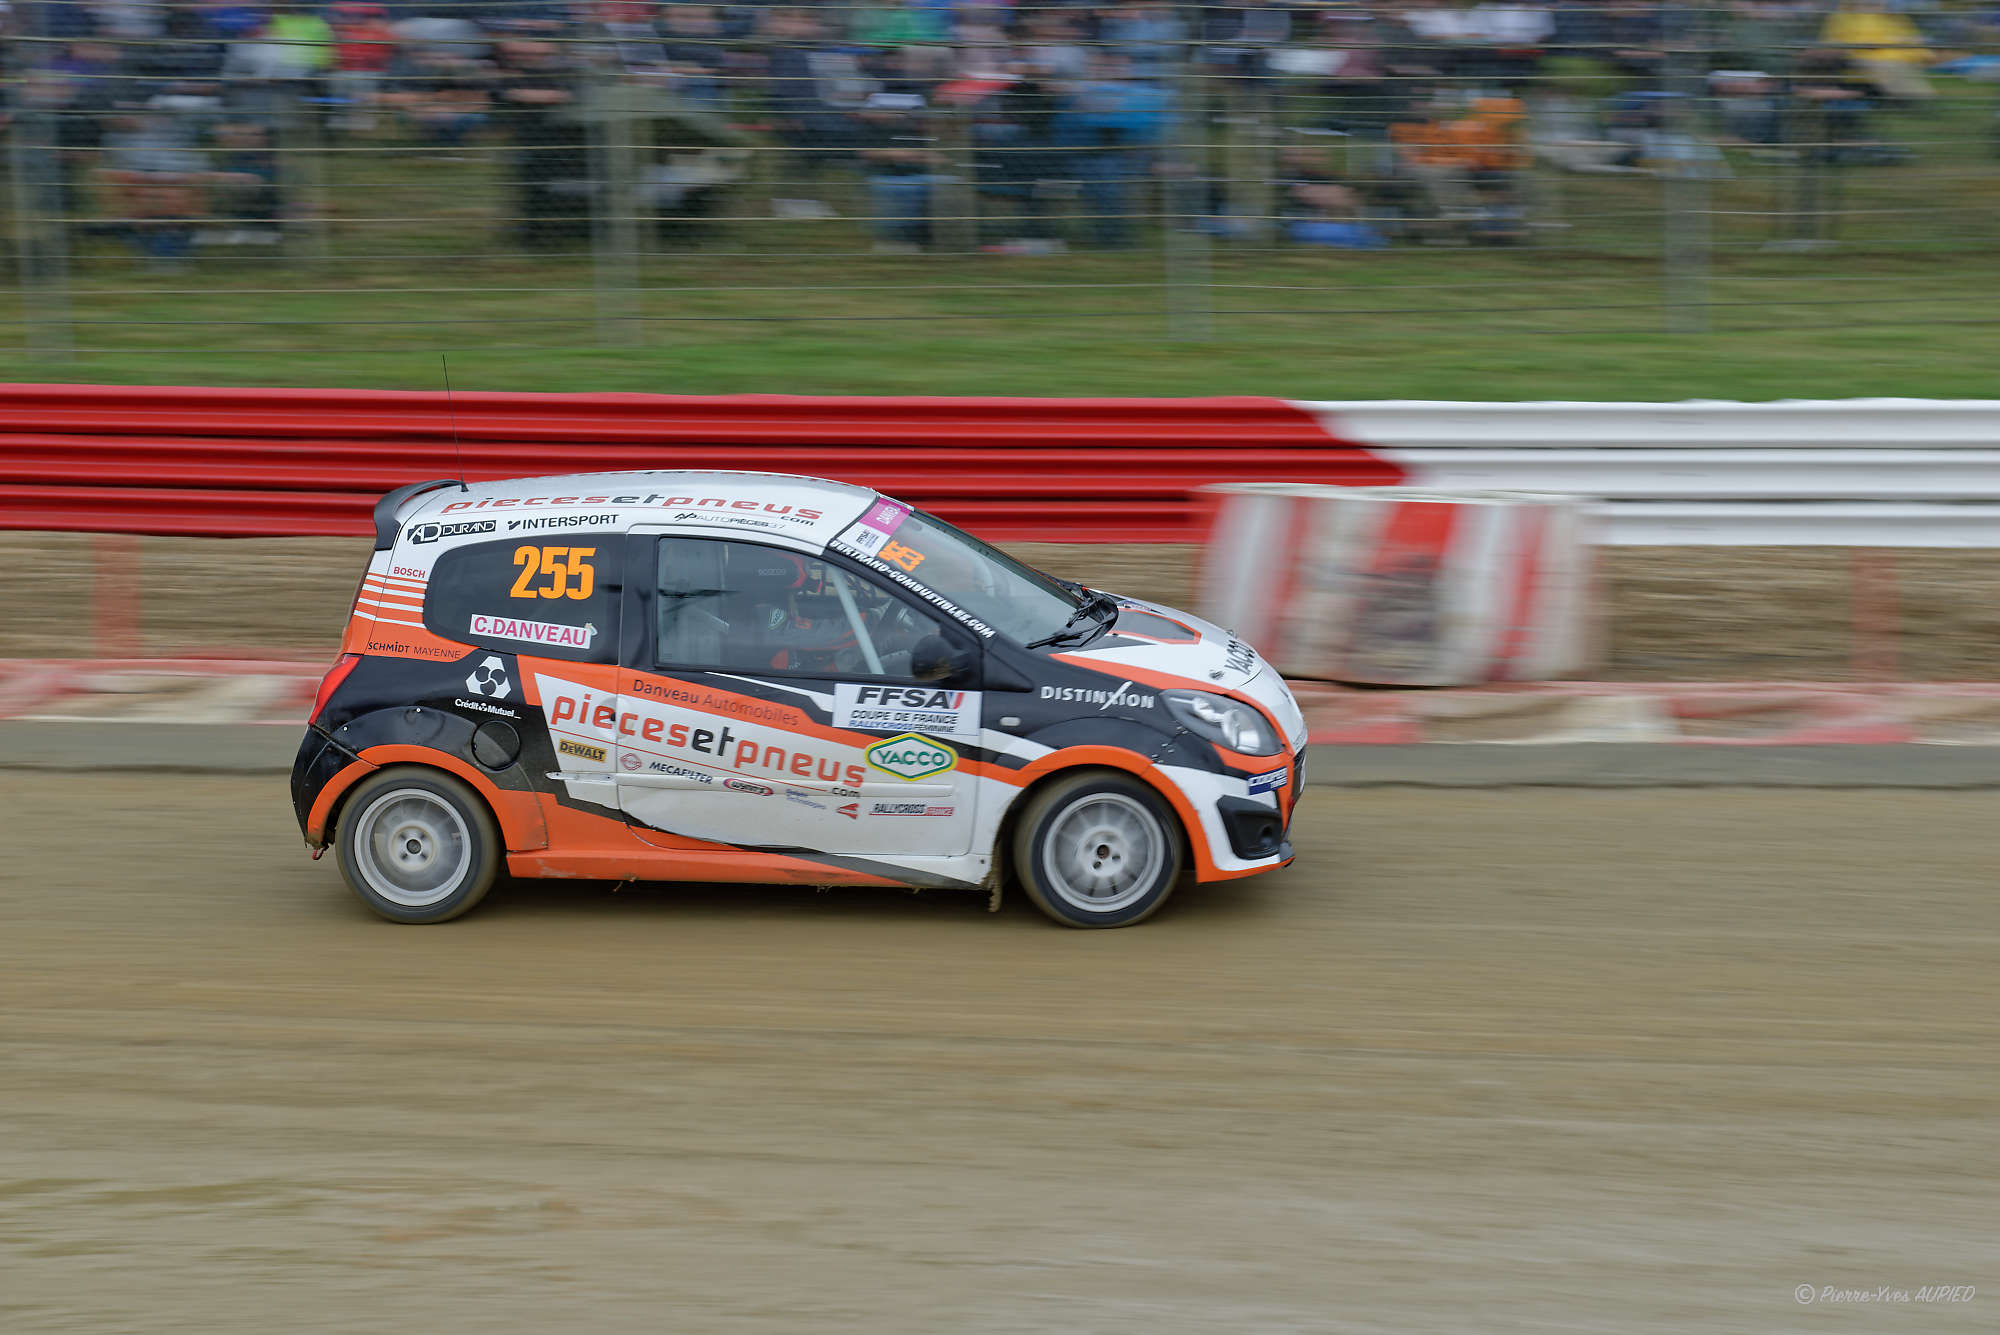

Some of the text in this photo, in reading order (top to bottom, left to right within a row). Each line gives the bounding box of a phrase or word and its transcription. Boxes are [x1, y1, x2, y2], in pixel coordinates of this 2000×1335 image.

[441, 494, 823, 520] piecesetpneus
[442, 521, 496, 536] DURAND
[523, 514, 619, 529] INTERSPORT
[393, 566, 426, 579] BOSCH
[510, 545, 597, 600] 255
[474, 617, 587, 646] C.DANVEAU
[413, 646, 461, 659] MAYENNE
[633, 679, 799, 727] Danveau Automobiles
[856, 686, 950, 710] FFSA
[1040, 680, 1155, 710] DISTINXION
[455, 698, 515, 717] Crédit Mutuel
[851, 710, 959, 725] COUPE DE FRANCE
[551, 693, 867, 788] piecesetpneus
[877, 750, 946, 767] YACCO
